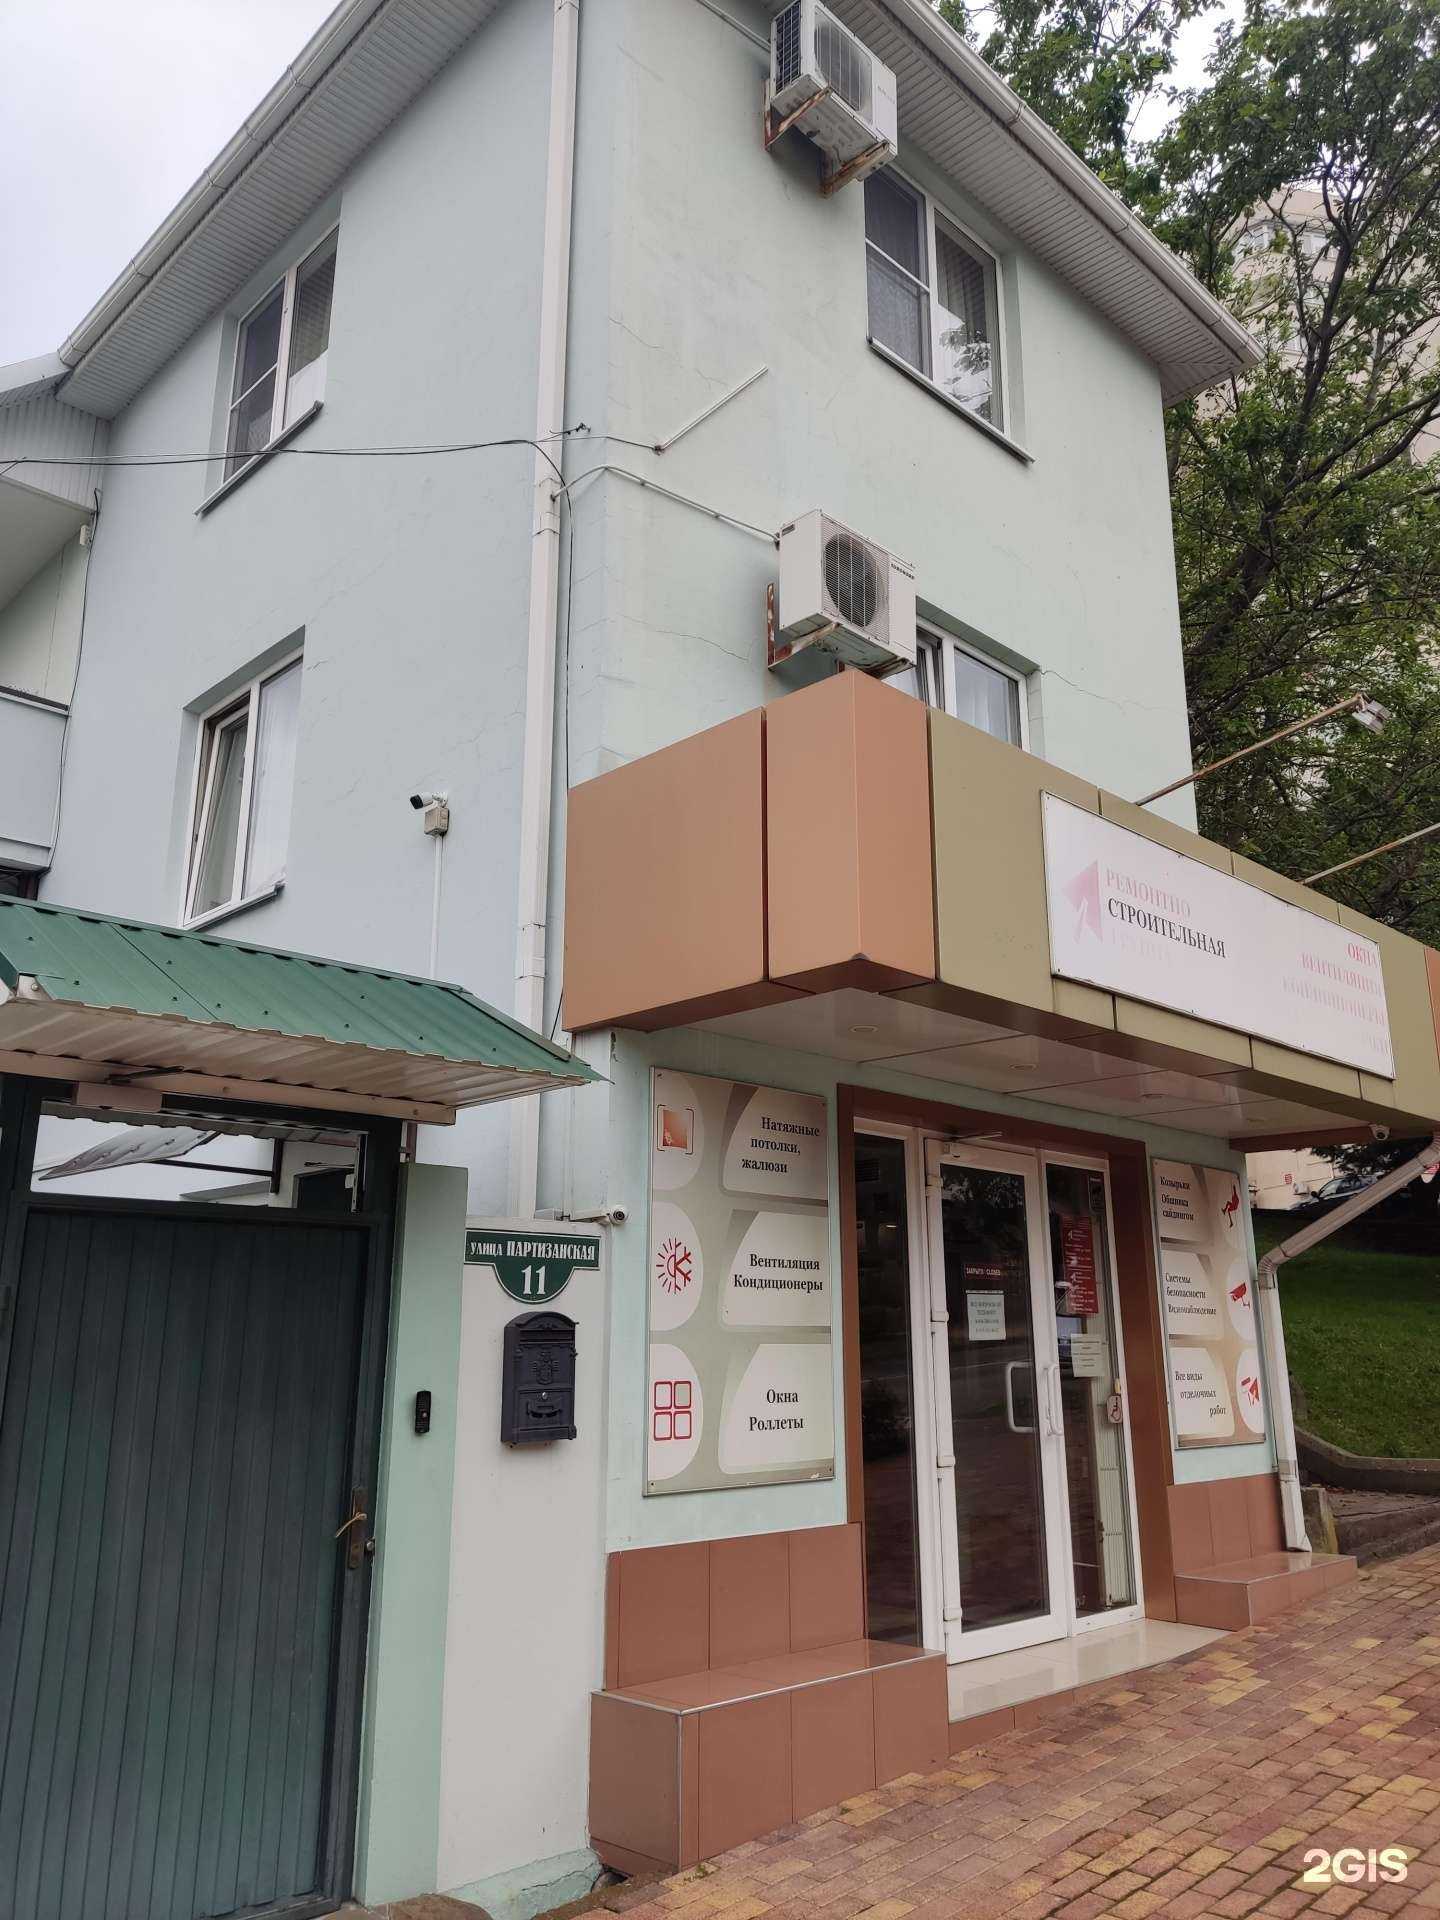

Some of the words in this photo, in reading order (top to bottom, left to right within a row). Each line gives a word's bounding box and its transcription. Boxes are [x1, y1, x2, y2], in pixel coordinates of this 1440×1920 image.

[1108, 897, 1226, 958] СТРОИТЕЛЬНАЯ
[761, 1117, 820, 1137] Натяжные
[751, 1138, 801, 1155] потолки,
[741, 1158, 788, 1173] жалюзи
[470, 1241, 503, 1257] УЛИЦА
[507, 1240, 596, 1261] ПАРТИЗАНСКАЯ
[750, 1254, 820, 1271] Вентиляция
[521, 1265, 546, 1295] 11
[734, 1275, 823, 1293] Кондиционеры
[766, 1389, 799, 1404] Окна
[750, 1416, 804, 1432] Роллеты
